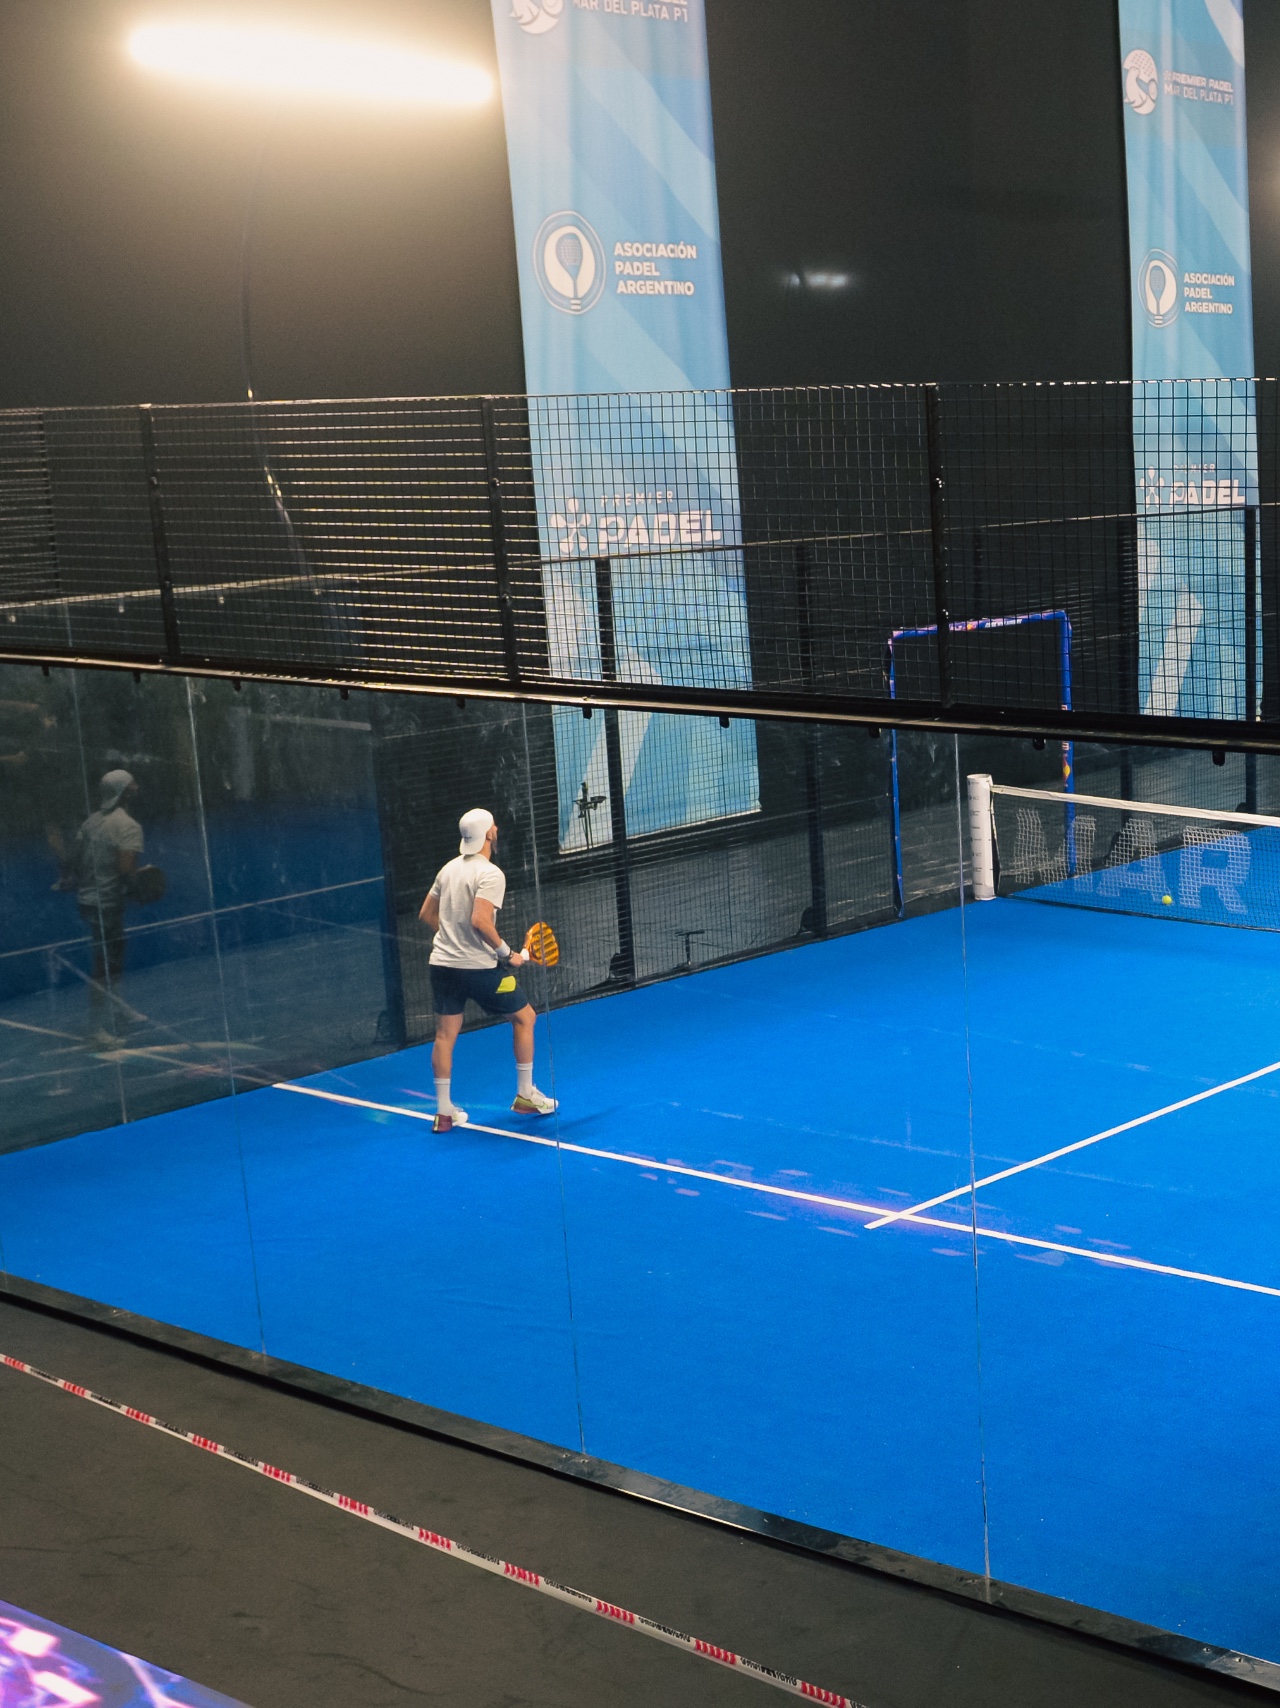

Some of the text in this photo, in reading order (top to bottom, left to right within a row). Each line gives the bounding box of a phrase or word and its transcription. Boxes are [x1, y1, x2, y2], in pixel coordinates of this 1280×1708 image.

[604, 0, 628, 15] DEL
[631, 1, 670, 20] PLATA
[673, 7, 688, 23] P1
[1172, 71, 1233, 93] PREMIER PADEL
[1183, 86, 1198, 100] DEL
[1200, 89, 1223, 104] PLATA
[1224, 93, 1234, 106] P1
[613, 240, 697, 260] ASOCIACIÓN
[614, 260, 660, 277] PADEL
[616, 279, 695, 296] ARGENTINO
[1183, 272, 1235, 287] ASOCIACIÓN
[1183, 287, 1213, 299] PADEL
[1184, 301, 1233, 315] ARGENTINO
[600, 490, 674, 508] PREMIER
[1169, 479, 1246, 508] PADEL
[598, 509, 723, 551] PADEL
[1013, 808, 1251, 915] MAR
